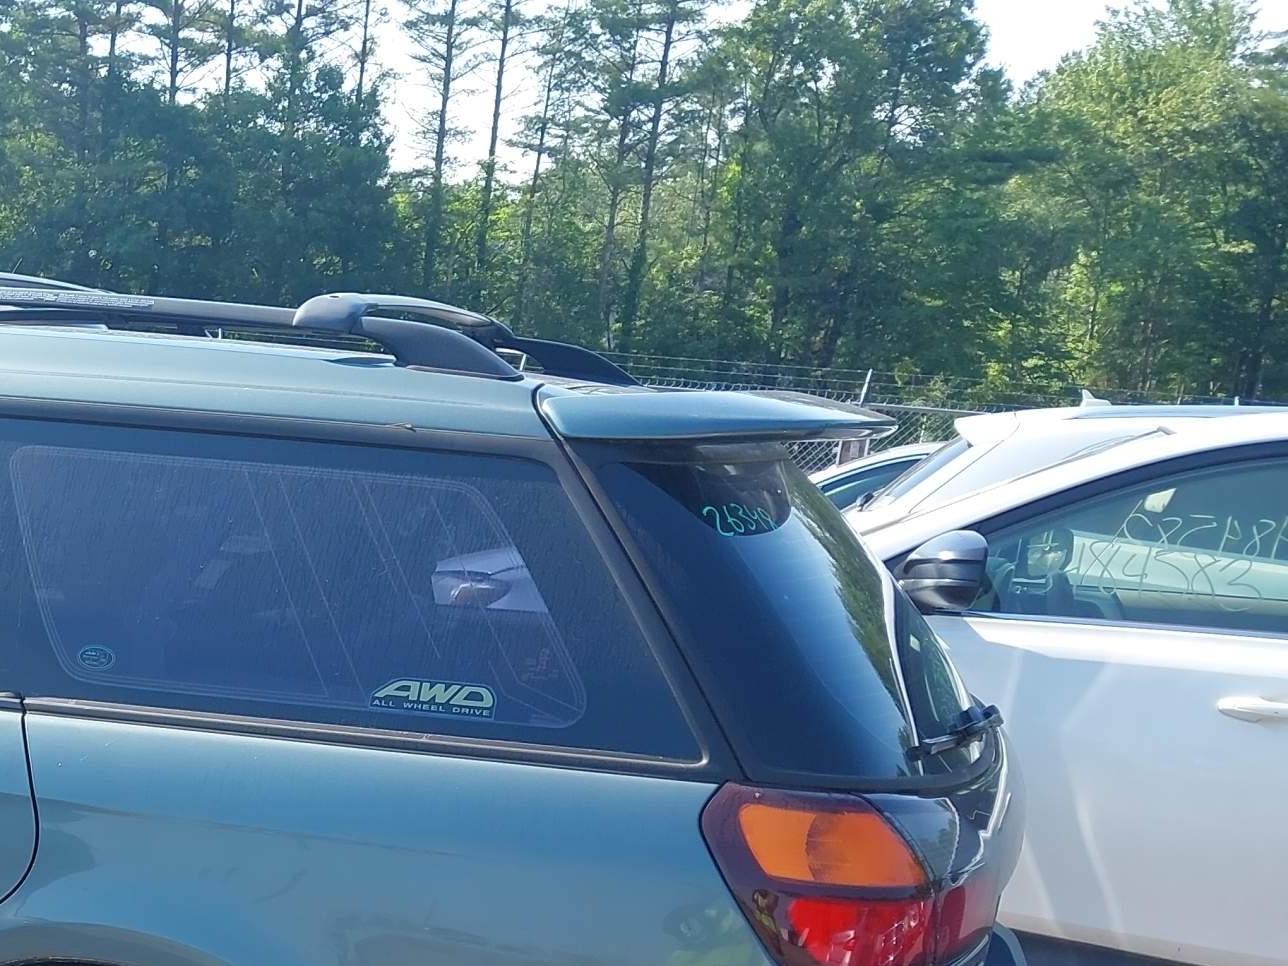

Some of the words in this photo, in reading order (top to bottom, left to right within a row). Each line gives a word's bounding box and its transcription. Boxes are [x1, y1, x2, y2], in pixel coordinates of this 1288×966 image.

[373, 679, 495, 708] AWD
[372, 699, 397, 708] ALL
[403, 702, 447, 713] WHEEL
[452, 706, 491, 717] DRIVE
